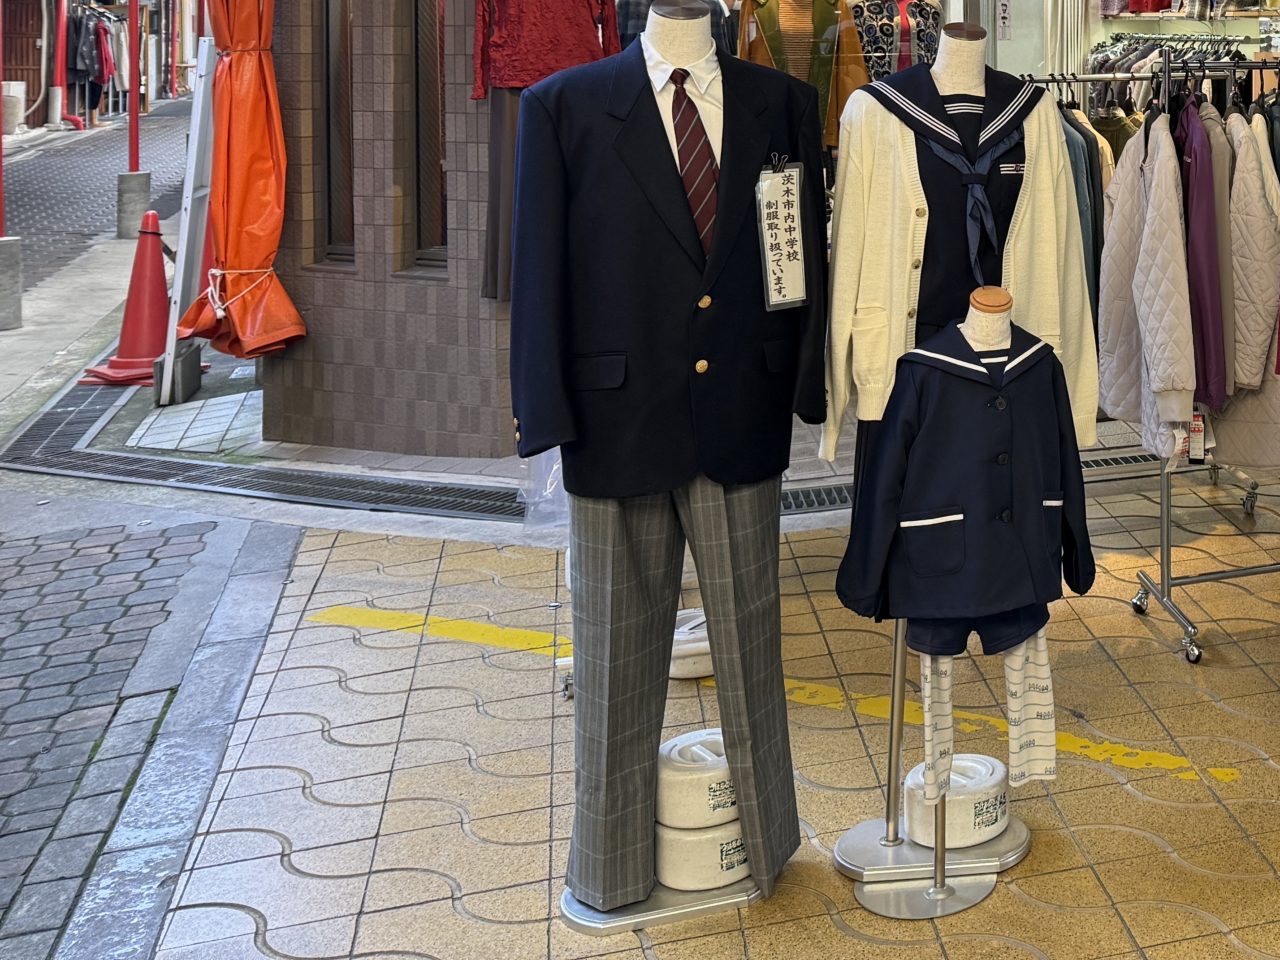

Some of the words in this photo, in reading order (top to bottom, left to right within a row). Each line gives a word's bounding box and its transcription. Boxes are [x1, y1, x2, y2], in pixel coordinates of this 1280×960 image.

[765, 200, 787, 299] 制服取り扱っています。
[781, 174, 800, 262] 茨木市内中学校
